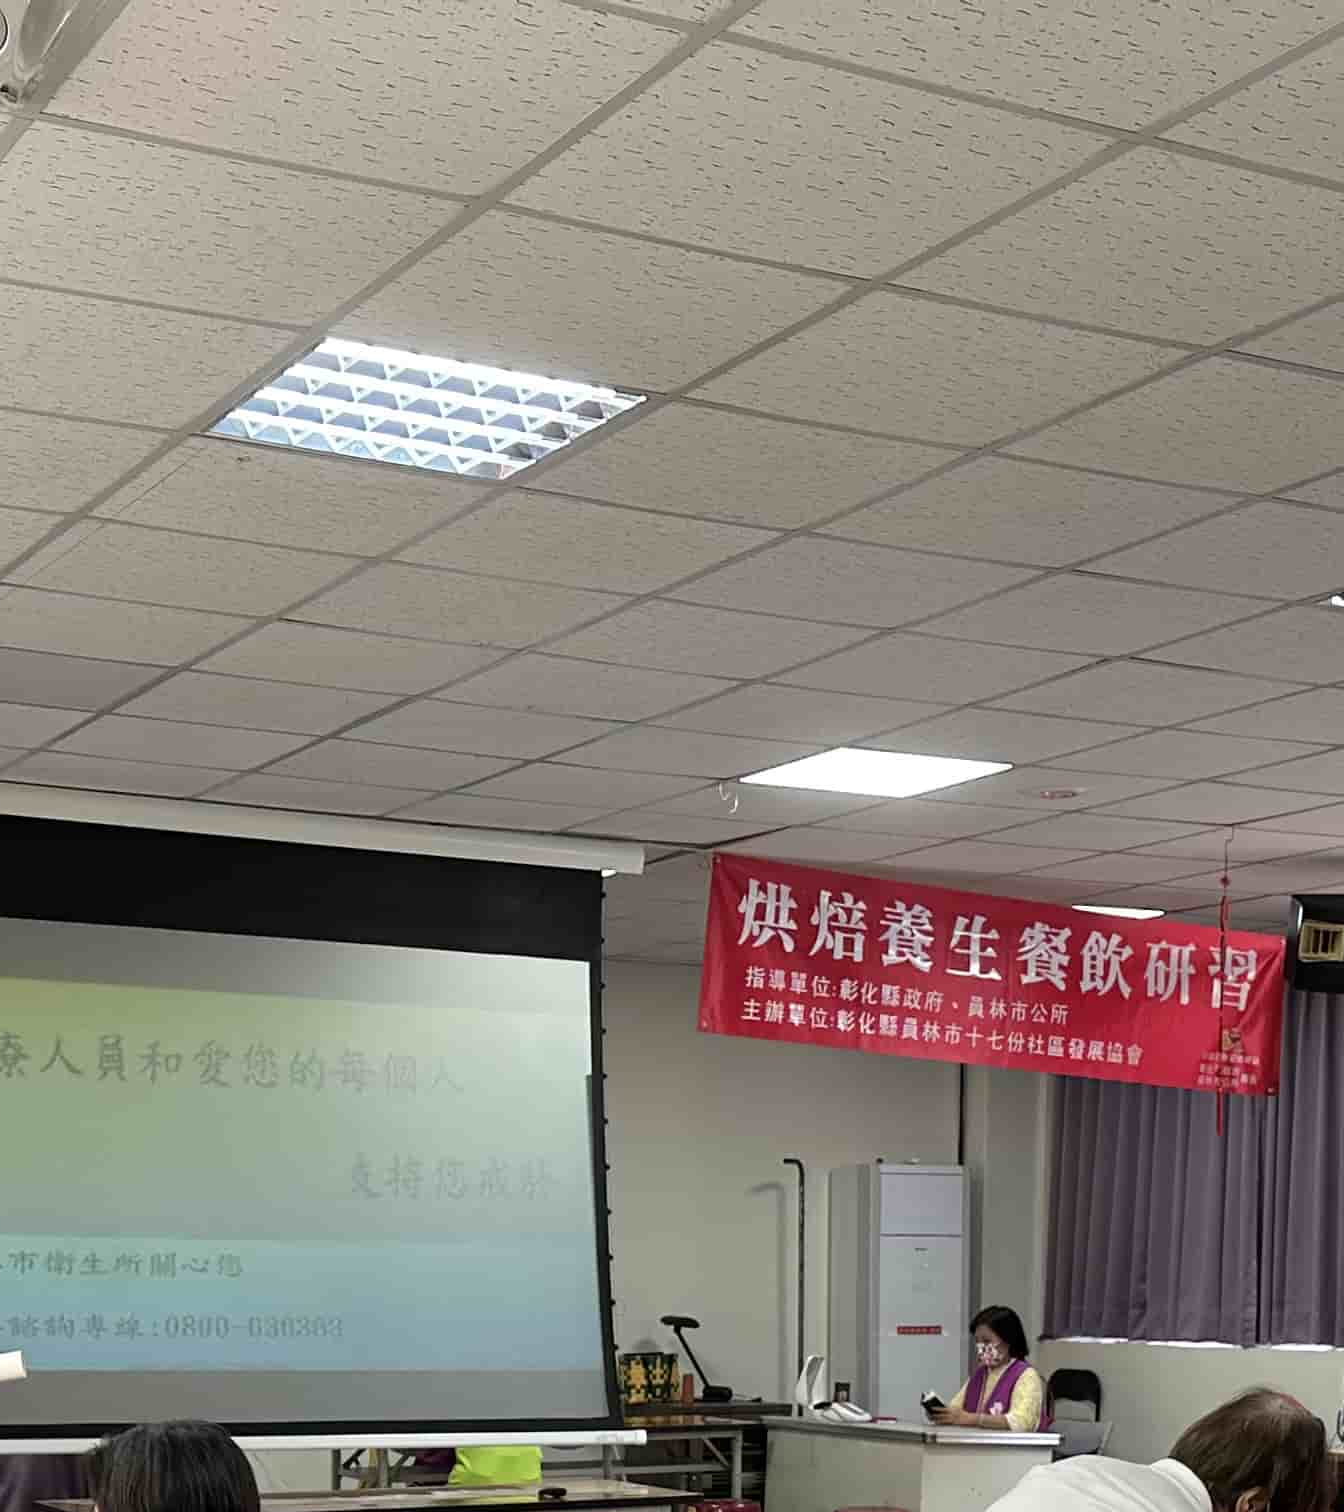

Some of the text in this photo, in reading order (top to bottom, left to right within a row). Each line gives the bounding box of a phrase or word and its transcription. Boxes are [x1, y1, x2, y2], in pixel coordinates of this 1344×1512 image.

[737, 878, 1257, 1012] 烘焙養生餐飲研習
[741, 999, 1143, 1067] 主辦單位:彰化縣員林市十七份社區發展協會
